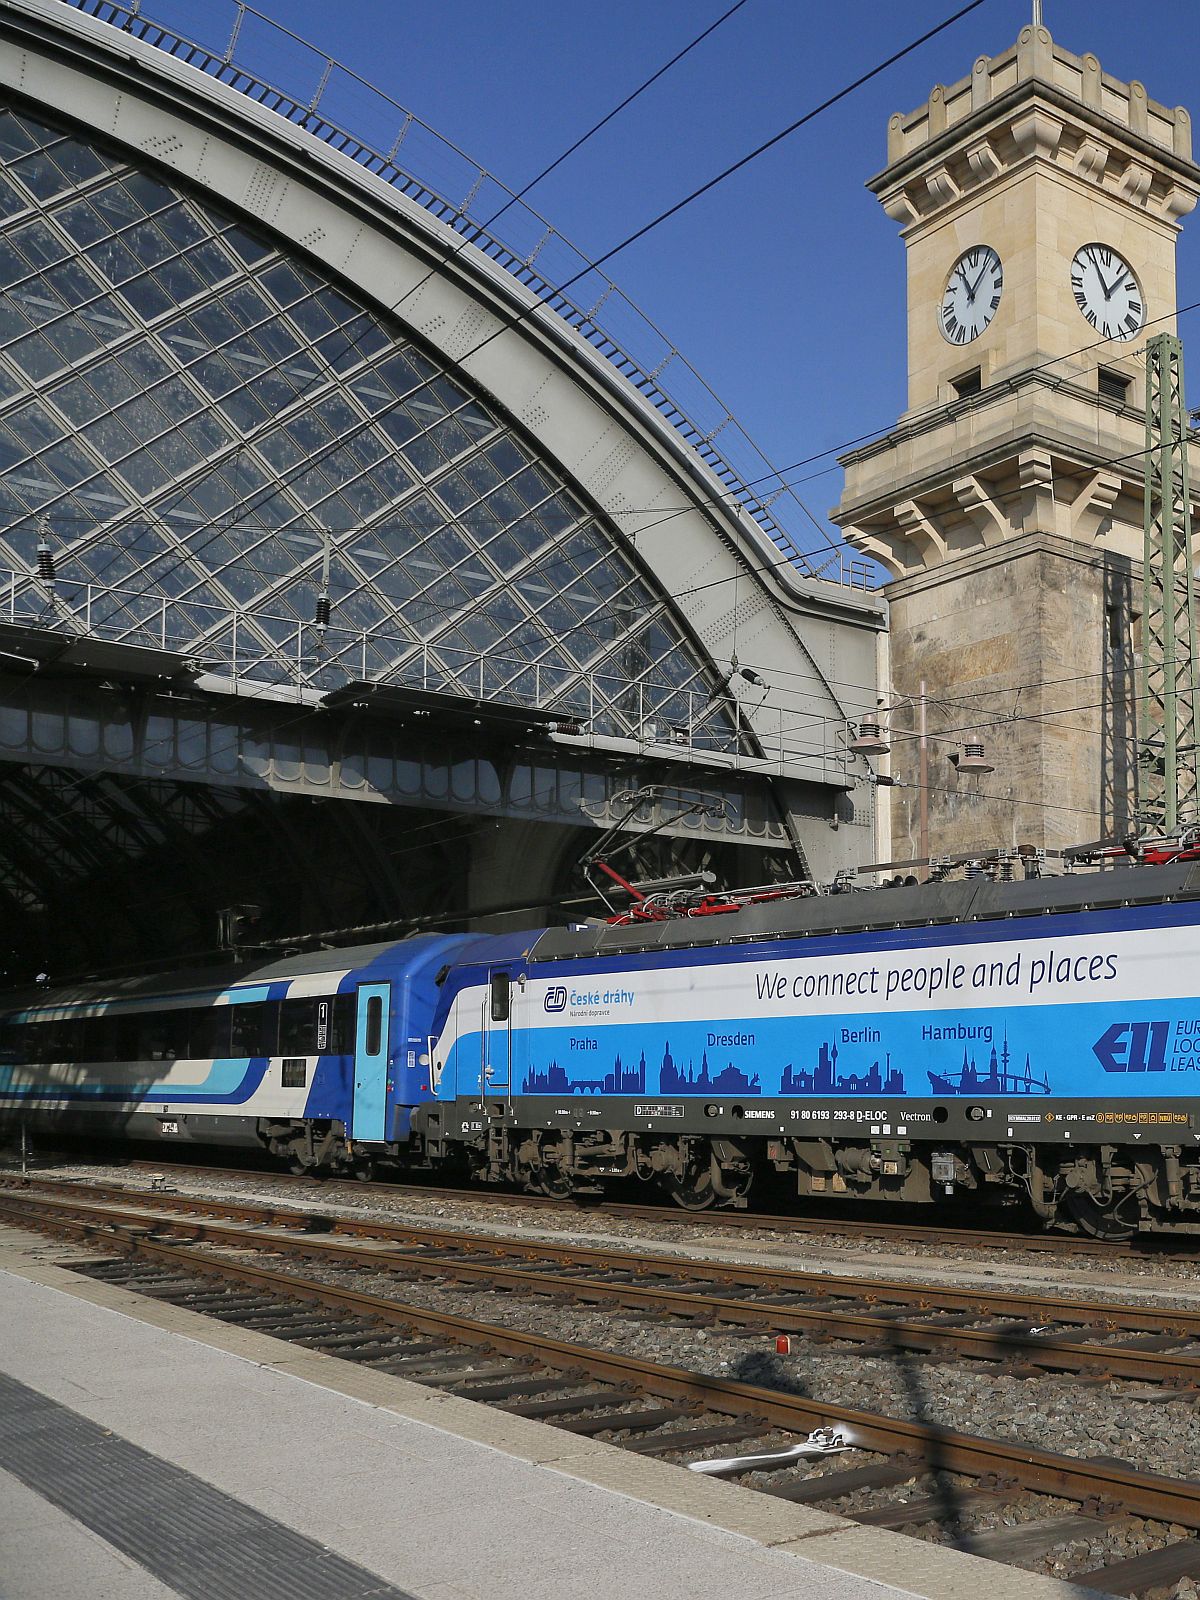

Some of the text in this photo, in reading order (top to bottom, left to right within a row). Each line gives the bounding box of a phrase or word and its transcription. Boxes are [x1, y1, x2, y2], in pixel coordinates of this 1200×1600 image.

[756, 950, 1118, 1001] We connect people and places
[570, 988, 635, 1007] České dráhy
[320, 1004, 325, 1018] 1
[707, 1031, 755, 1047] Dresden
[841, 1027, 881, 1043] Berlin
[922, 1023, 993, 1043] Hamburg
[570, 1037, 598, 1051] Praha
[744, 1110, 775, 1119] SIEMENS
[790, 1110, 888, 1122] 91 80 6193 293-8 D-ELOC
[900, 1111, 932, 1121] Vectron
